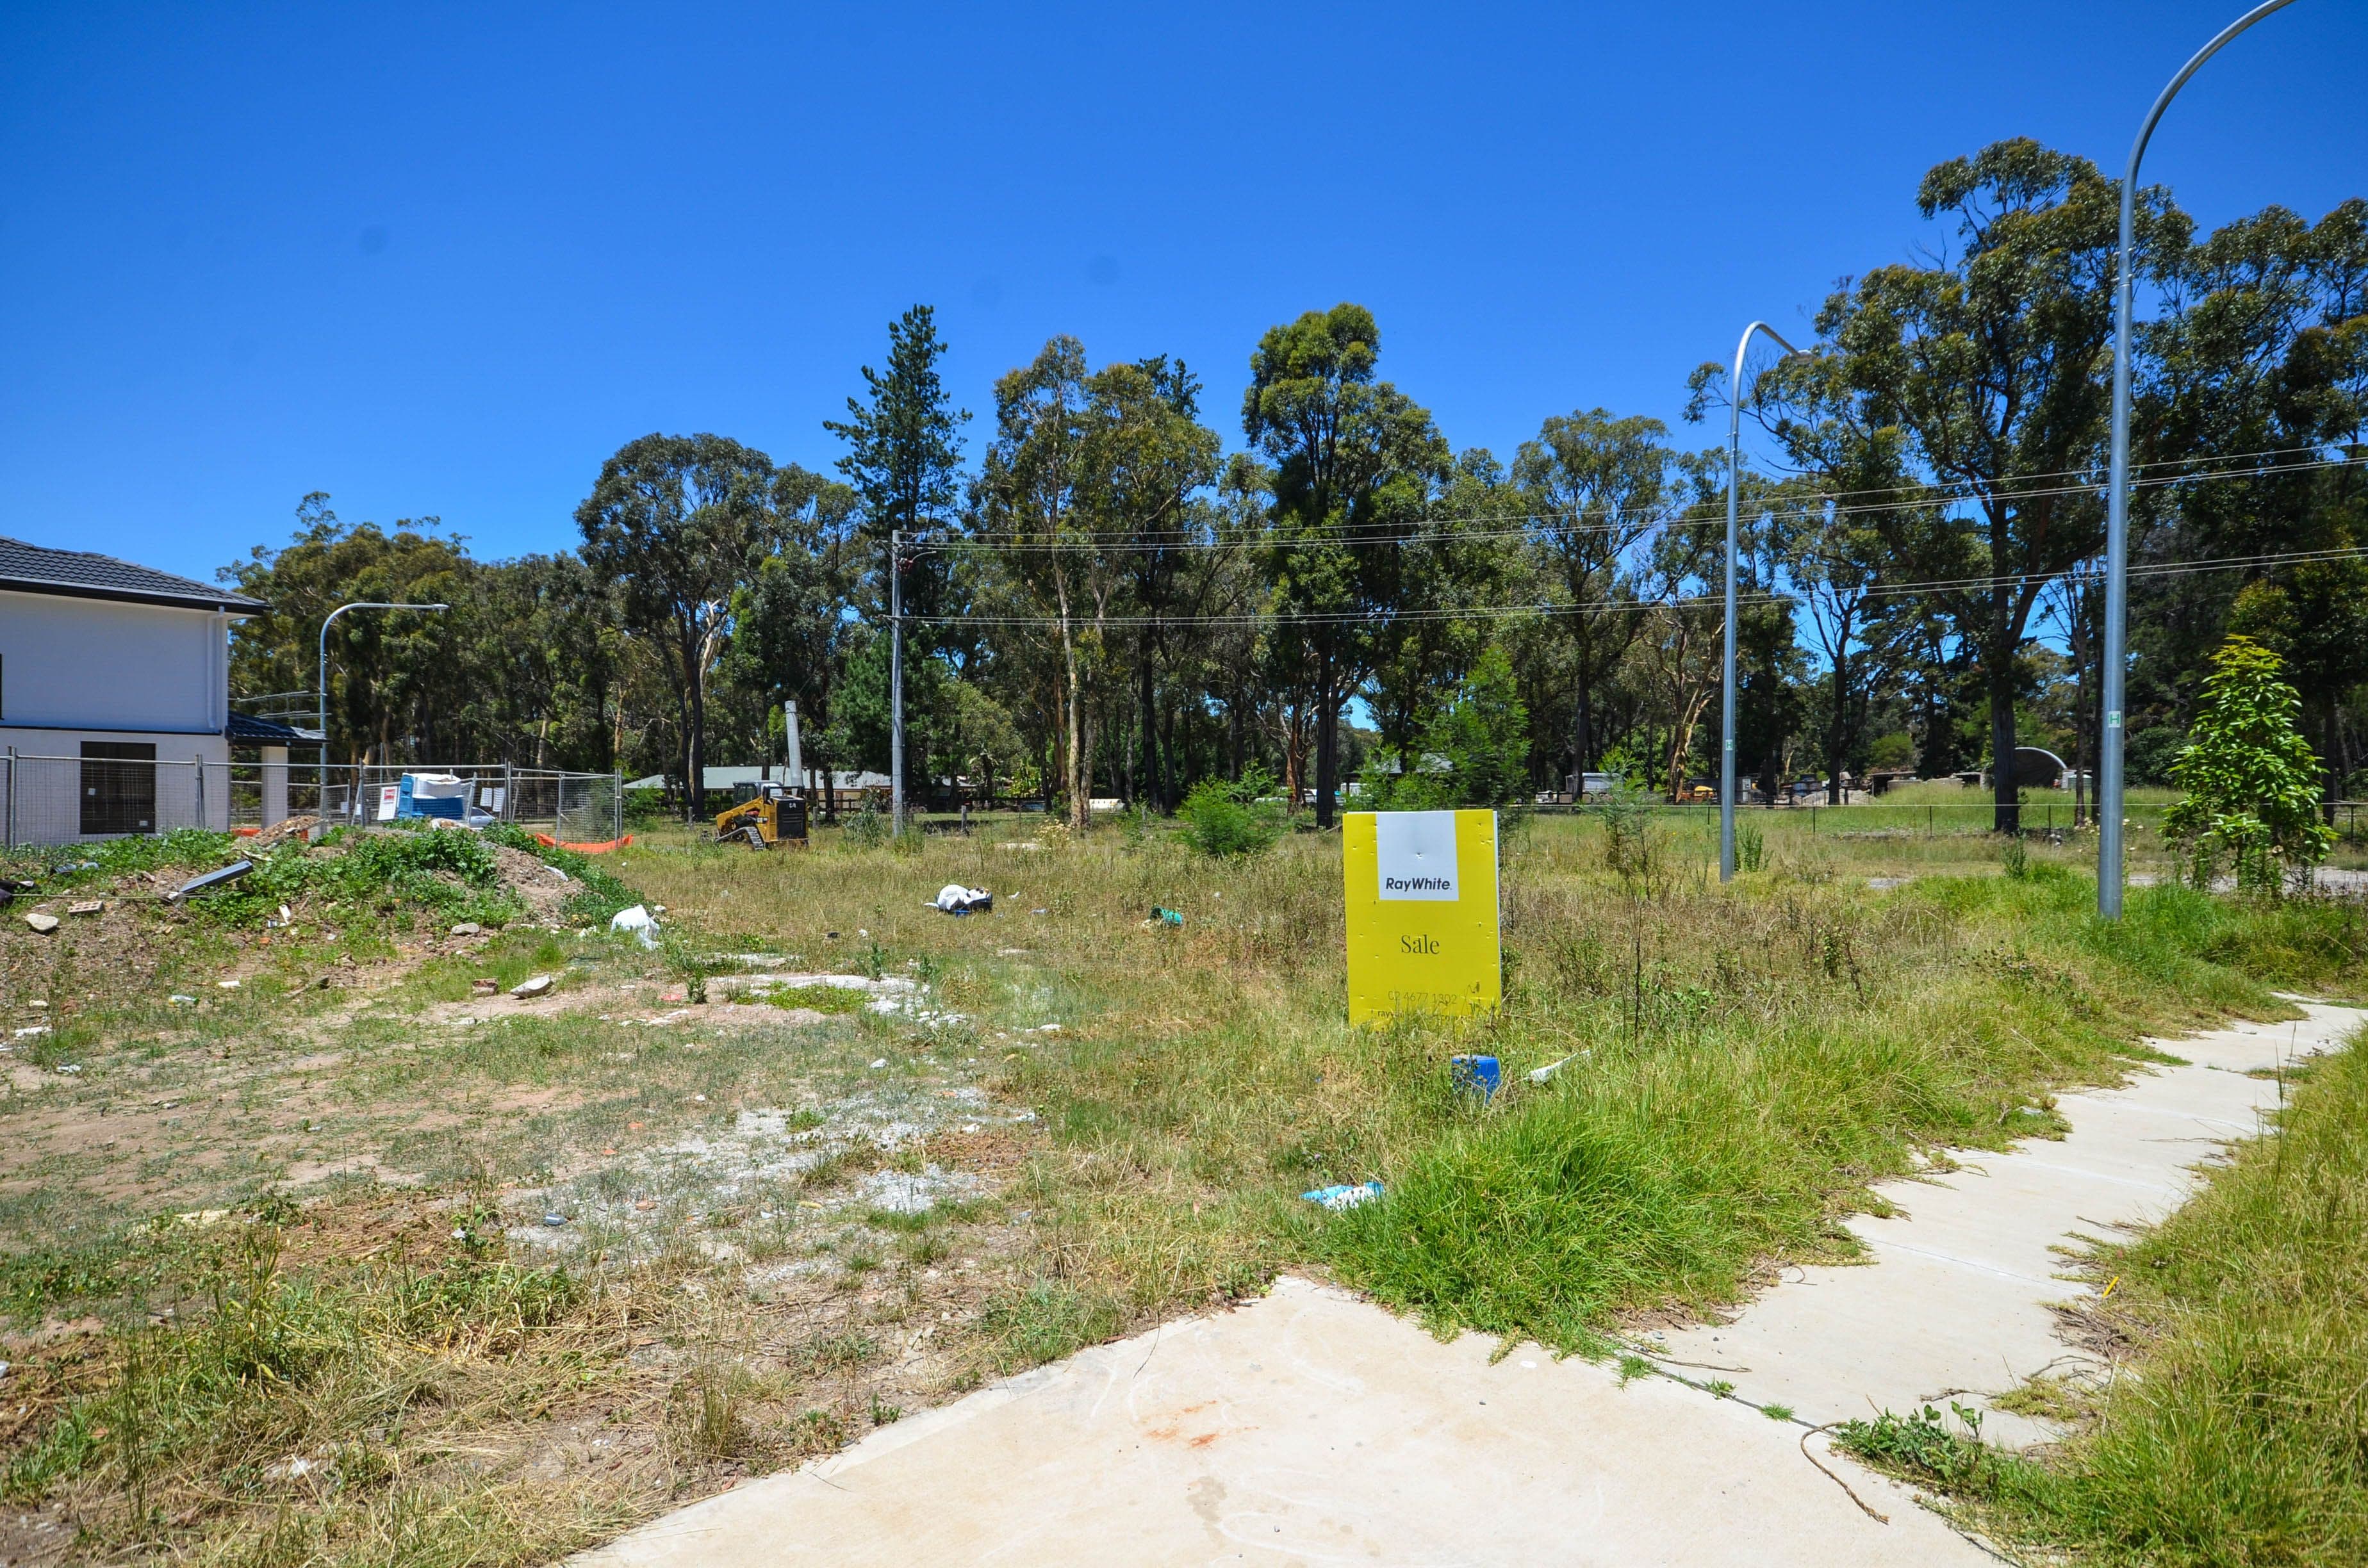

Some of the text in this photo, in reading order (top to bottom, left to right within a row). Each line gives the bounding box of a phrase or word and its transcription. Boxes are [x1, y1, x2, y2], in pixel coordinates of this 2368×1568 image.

[2110, 714, 2119, 724] H
[1401, 934, 1440, 954] Sale
[1404, 992, 1429, 1002] 4677
